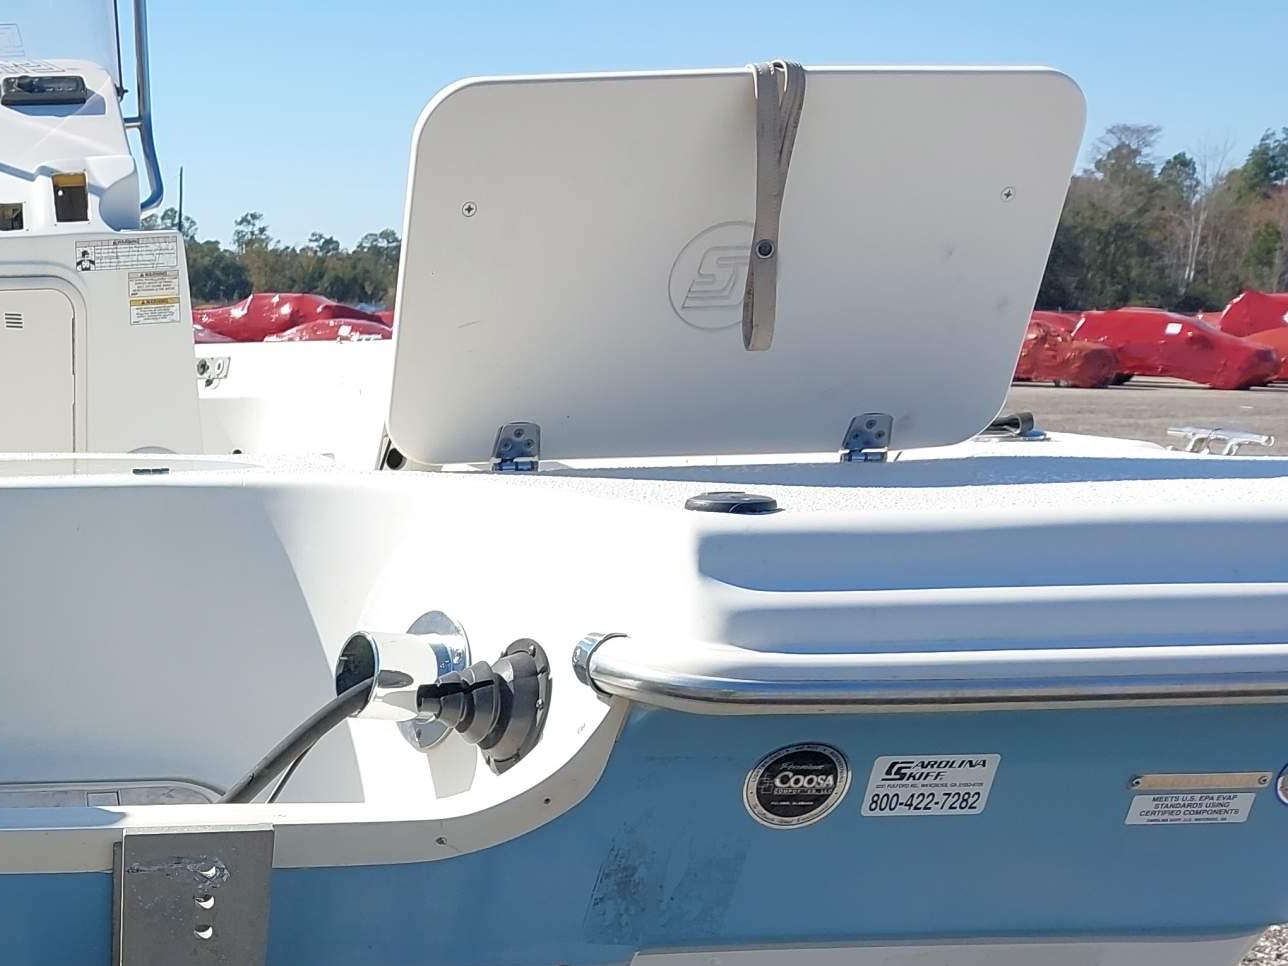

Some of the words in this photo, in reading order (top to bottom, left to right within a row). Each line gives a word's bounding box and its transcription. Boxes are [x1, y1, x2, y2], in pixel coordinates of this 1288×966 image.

[884, 759, 987, 776] CAROLINA
[774, 771, 834, 788] COOSA
[869, 791, 981, 812] 800-422-7282
[1183, 808, 1240, 816] COMPONENTS
